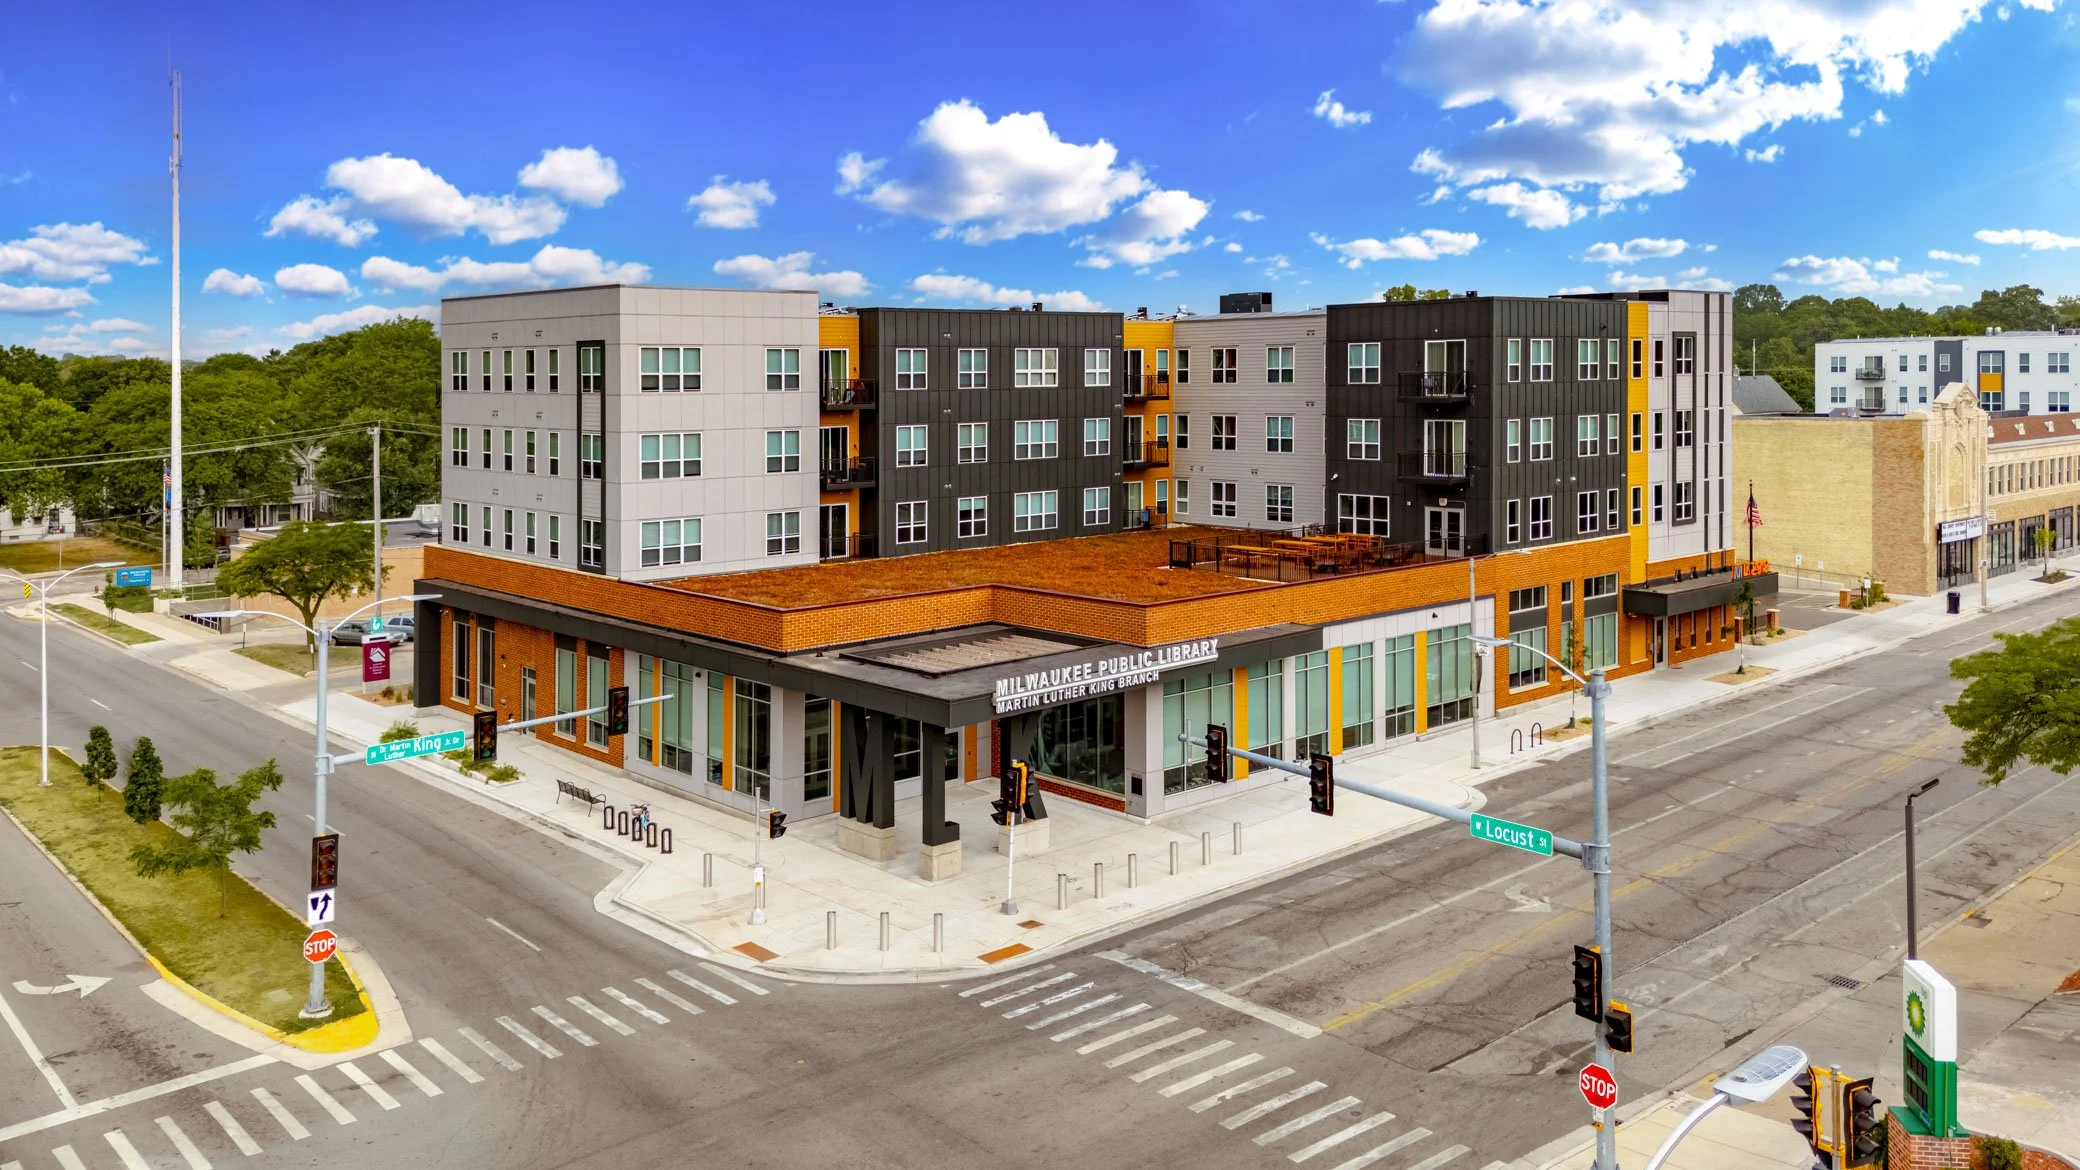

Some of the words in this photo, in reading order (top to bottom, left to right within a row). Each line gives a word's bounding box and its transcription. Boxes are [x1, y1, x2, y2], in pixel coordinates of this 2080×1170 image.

[996, 663, 1093, 697] MILWAUKEE
[1098, 651, 1153, 676] PUBLIC
[1157, 638, 1219, 664] LIBRARY
[996, 696, 1040, 713] MARTIN
[1043, 686, 1086, 704] LUTHER
[1088, 679, 1115, 694] KING
[1118, 670, 1160, 688] BRANCH
[389, 742, 411, 751] Martin
[413, 738, 442, 752] King
[371, 751, 377, 759] N
[384, 751, 406, 760] Luther
[1475, 821, 1482, 830] W
[1486, 820, 1534, 848] Locust
[1539, 837, 1547, 847] St
[305, 937, 336, 955] STOP
[1581, 1073, 1616, 1099] STOP
